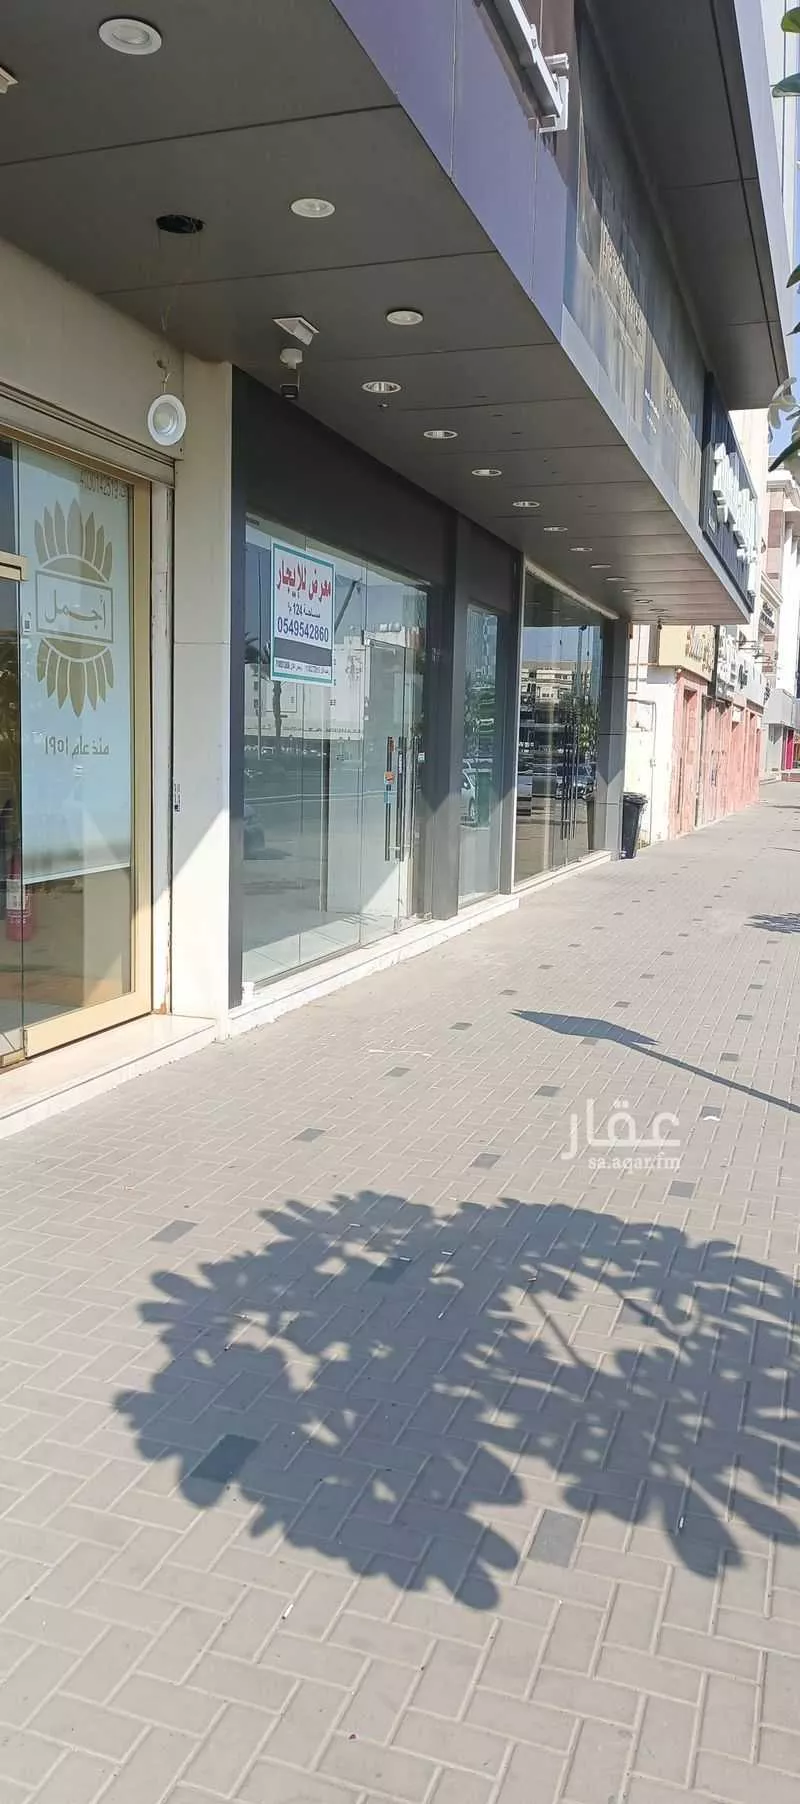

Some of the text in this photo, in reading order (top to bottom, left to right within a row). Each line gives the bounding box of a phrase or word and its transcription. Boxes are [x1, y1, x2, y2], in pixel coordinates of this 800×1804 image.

[308, 569, 331, 602] معرض
[45, 589, 106, 631] أجمل
[293, 602, 303, 616] 124
[303, 603, 321, 618] مساحة
[277, 616, 329, 642] 0549542860
[71, 735, 90, 760] عام
[92, 737, 110, 756] منذ
